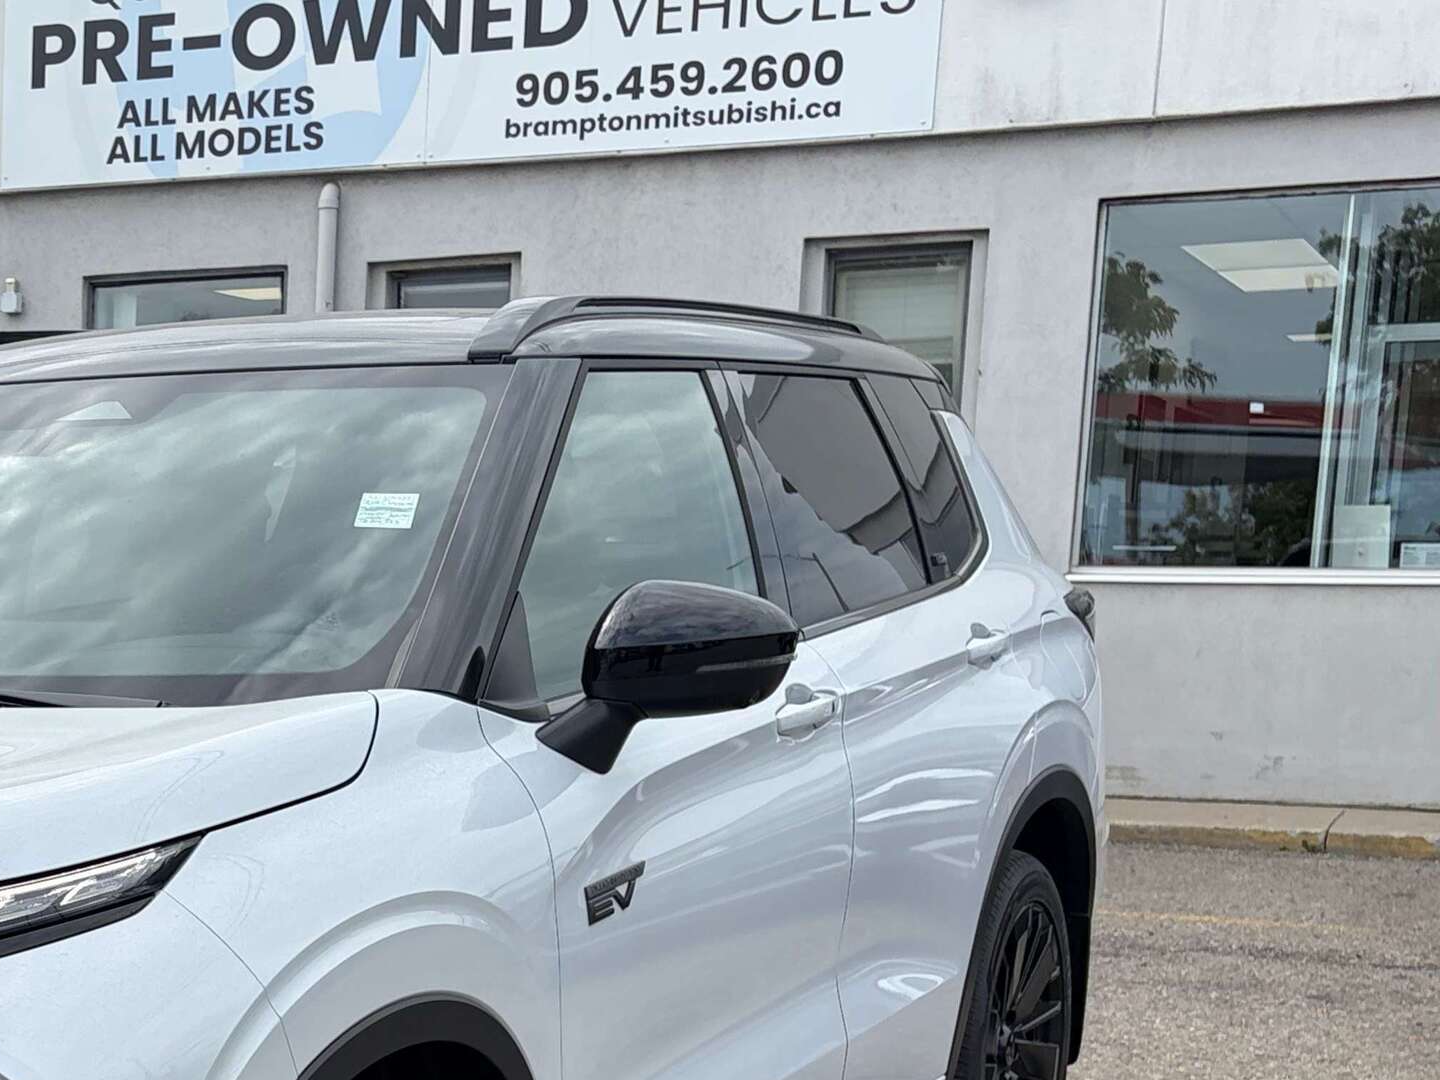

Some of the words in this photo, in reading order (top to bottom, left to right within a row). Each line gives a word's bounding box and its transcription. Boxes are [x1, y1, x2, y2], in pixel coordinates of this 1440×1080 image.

[31, 0, 589, 89] PRE-OWNED
[611, 0, 917, 38] VEHI
[515, 49, 845, 108] 905.459.2600
[116, 97, 176, 129] ALL
[186, 85, 315, 124] MAKES
[504, 97, 842, 140] bramptonmitsubishi.ca
[105, 132, 165, 165] ALL
[174, 121, 325, 160] MODELS
[583, 860, 646, 927] EV
